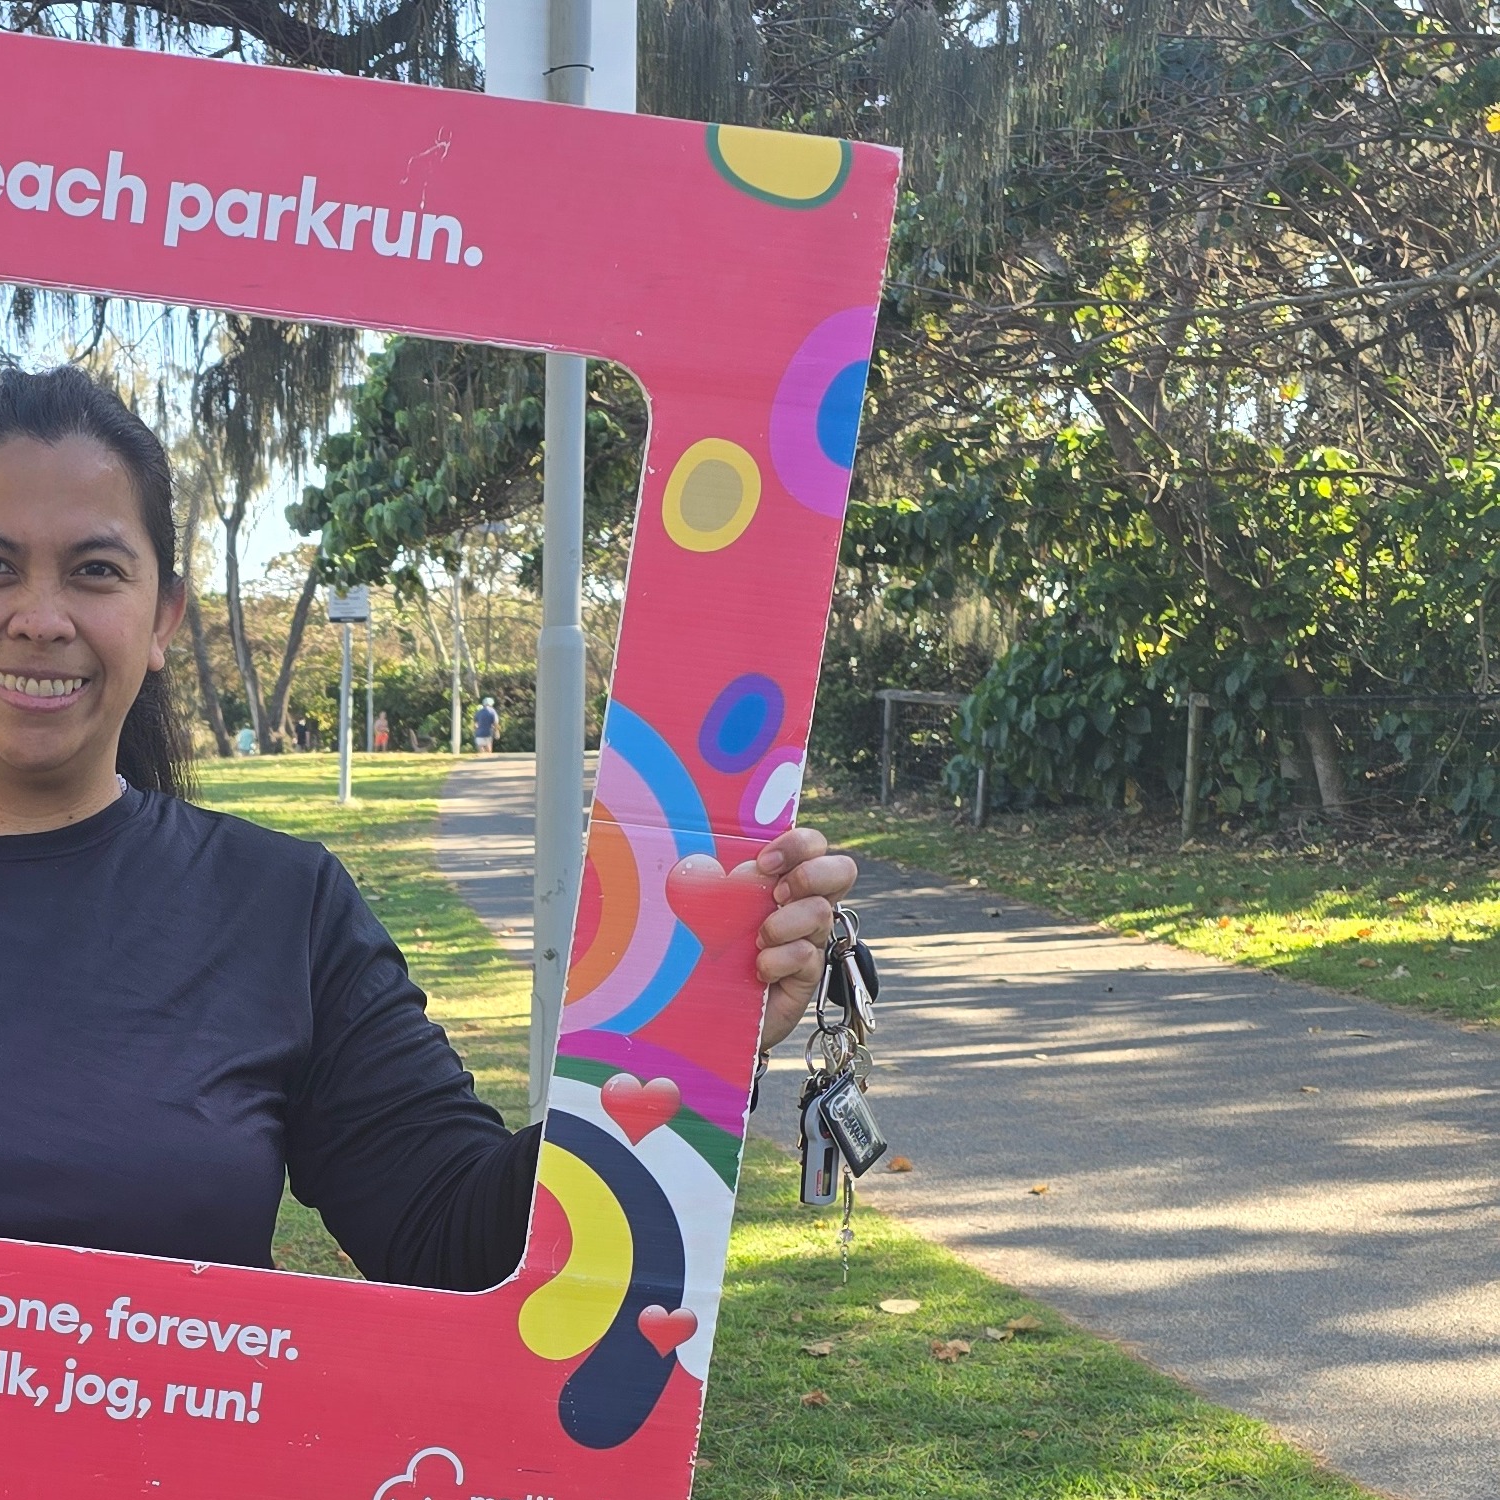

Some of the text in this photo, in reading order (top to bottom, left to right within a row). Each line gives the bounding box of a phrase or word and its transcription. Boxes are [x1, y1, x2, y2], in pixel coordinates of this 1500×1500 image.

[162, 174, 485, 267] parkrun.
[105, 1295, 299, 1361] forever.
[54, 1357, 152, 1421] jog,
[163, 1381, 263, 1424] run!
